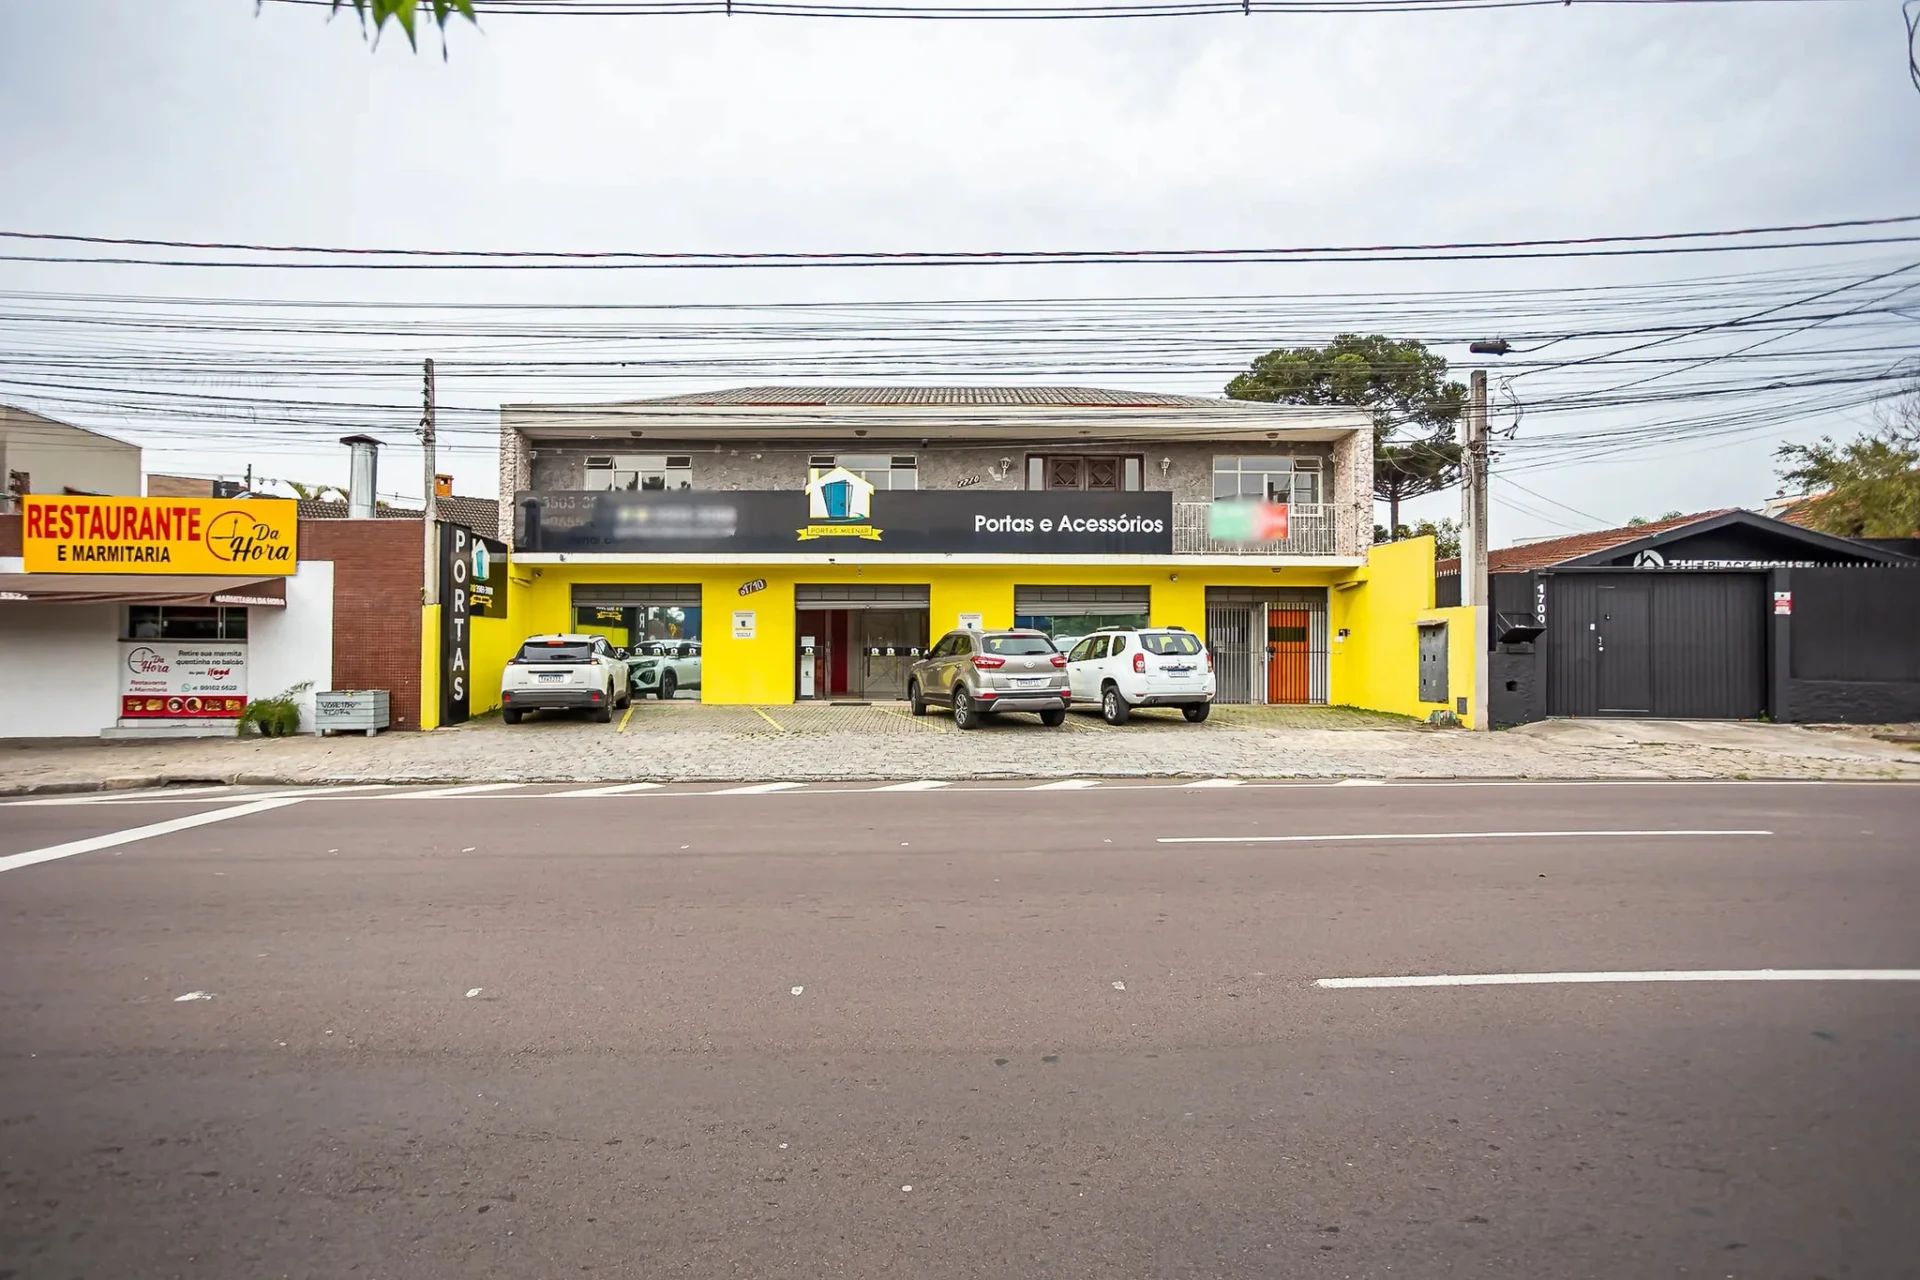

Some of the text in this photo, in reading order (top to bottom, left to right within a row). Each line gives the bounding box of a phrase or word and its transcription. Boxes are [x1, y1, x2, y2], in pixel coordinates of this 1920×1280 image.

[27, 504, 202, 542] RESTAURANTE
[252, 523, 281, 541] Da
[810, 526, 870, 535] PORTAS MILENAR
[974, 513, 1165, 533] Portas e Acessórios
[57, 545, 171, 563] E MARMITARIA
[229, 536, 293, 562] Hora
[1537, 583, 1546, 624] 1700
[453, 529, 467, 701] PORTAS
[141, 660, 170, 674] Hora
[175, 658, 211, 666] quentinha
